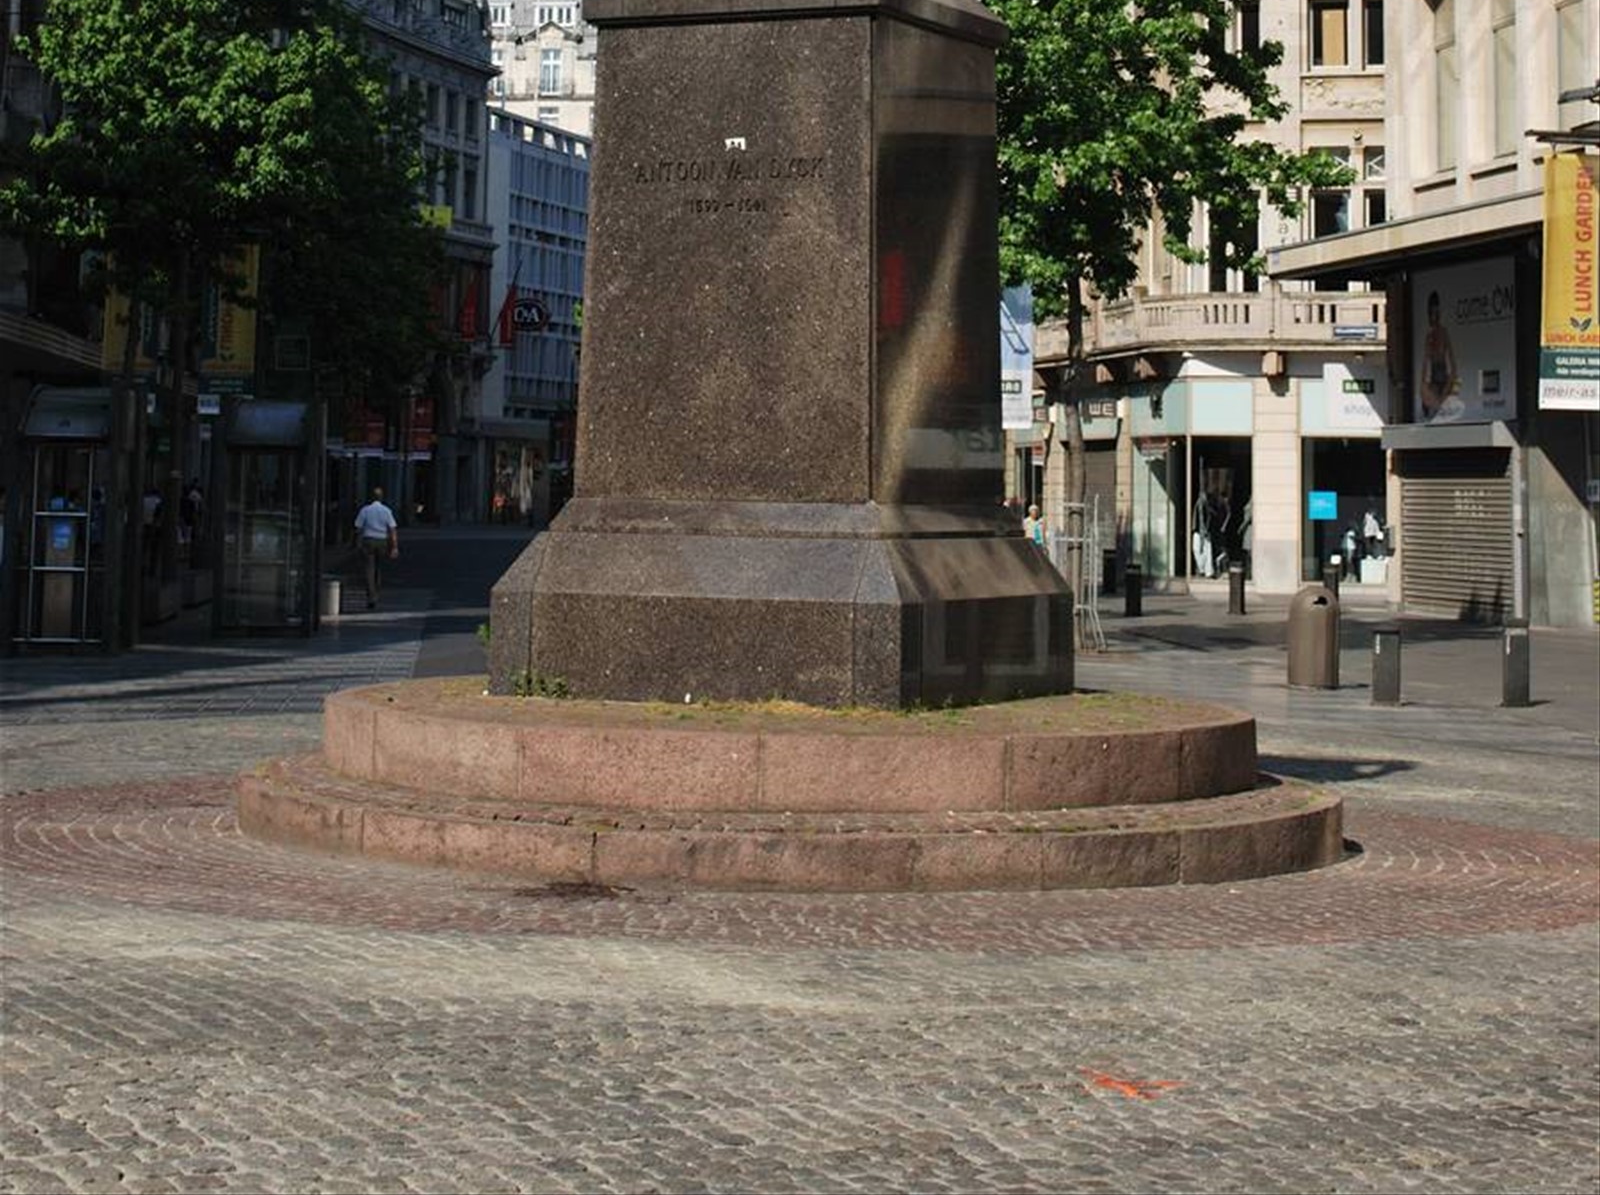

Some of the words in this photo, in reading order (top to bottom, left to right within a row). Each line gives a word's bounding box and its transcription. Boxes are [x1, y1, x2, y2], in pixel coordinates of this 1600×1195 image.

[1575, 166, 1593, 242] GARDEN
[1574, 249, 1592, 312] LUNCH
[1088, 402, 1114, 416] WE
